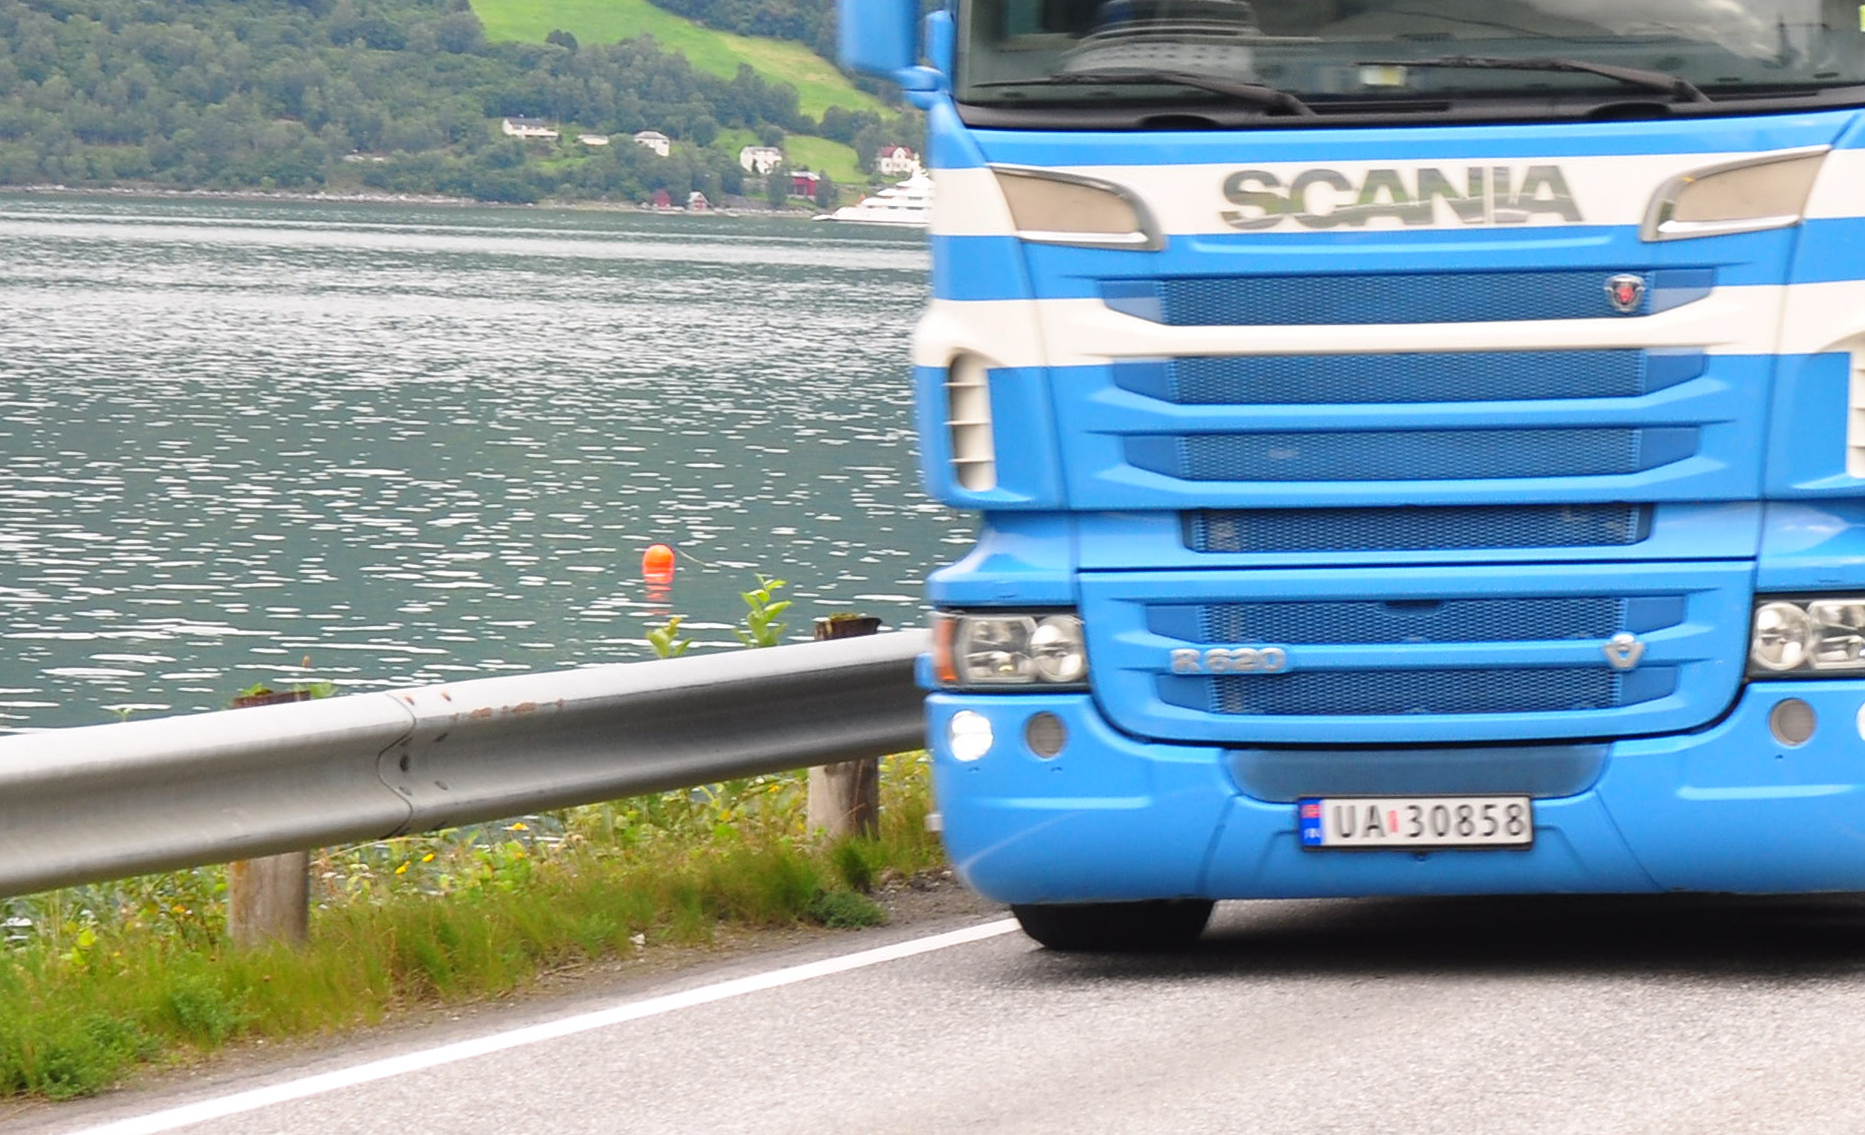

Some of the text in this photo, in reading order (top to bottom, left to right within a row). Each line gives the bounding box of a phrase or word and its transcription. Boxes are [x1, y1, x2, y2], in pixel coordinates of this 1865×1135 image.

[1219, 165, 1584, 229] SCANIA
[1170, 647, 1287, 674] R 620
[1332, 802, 1526, 838] UA 30858
